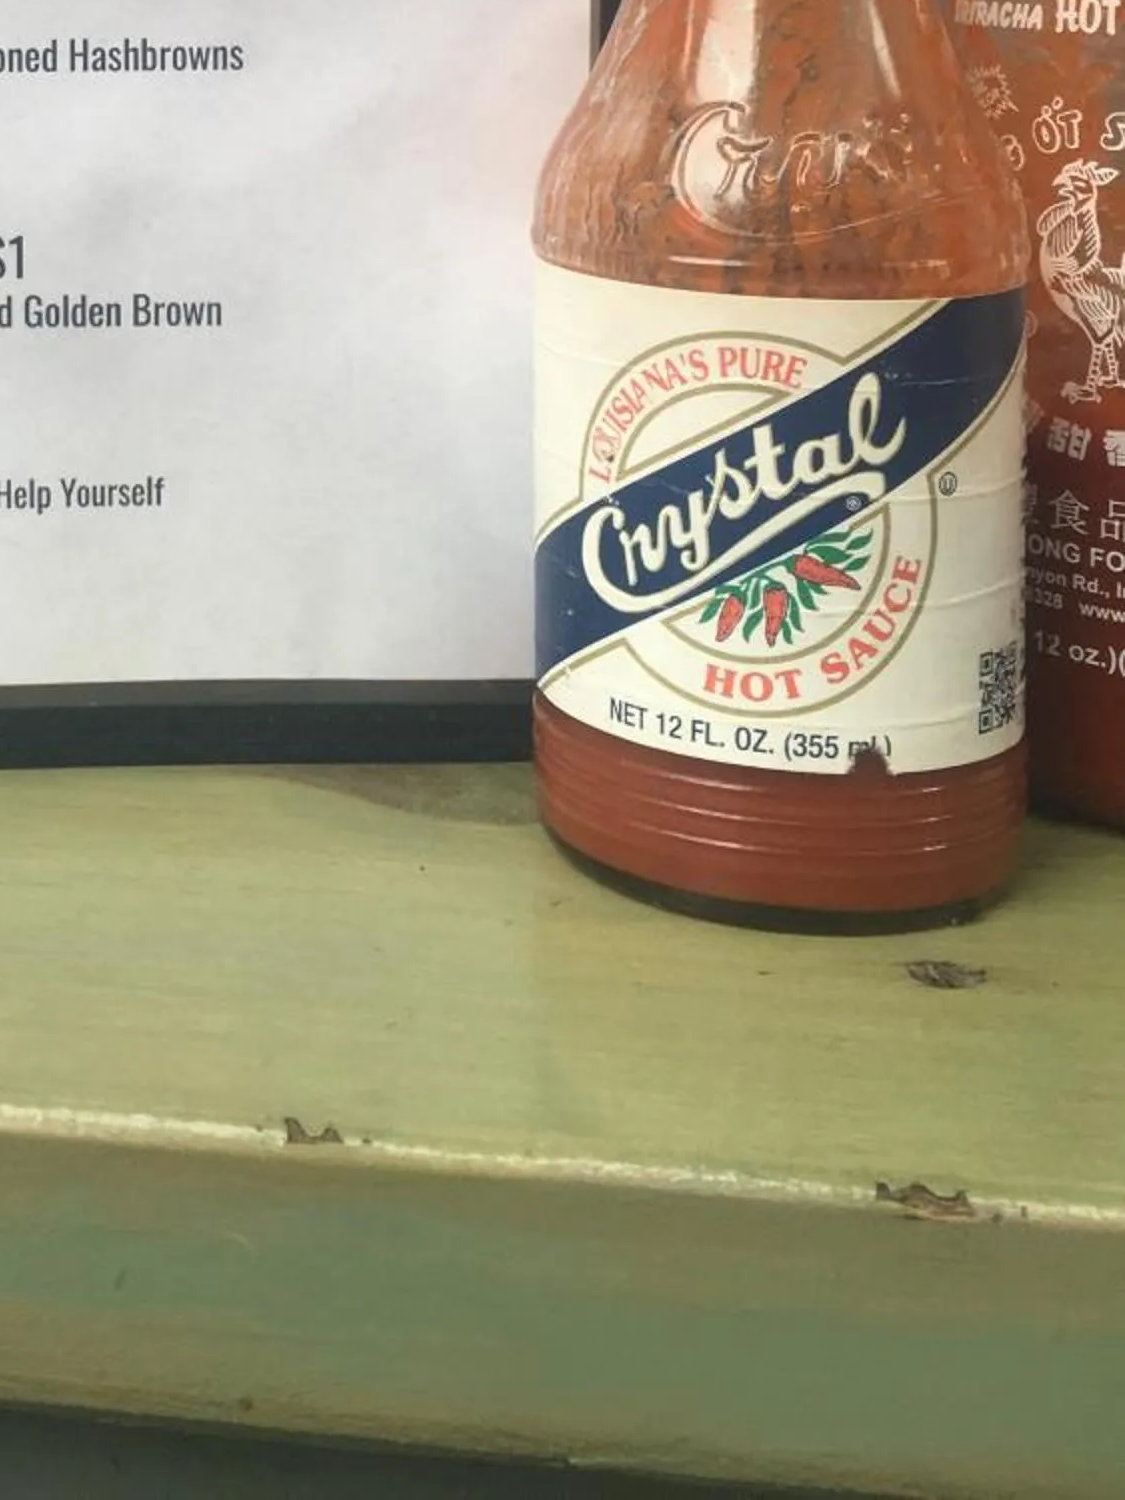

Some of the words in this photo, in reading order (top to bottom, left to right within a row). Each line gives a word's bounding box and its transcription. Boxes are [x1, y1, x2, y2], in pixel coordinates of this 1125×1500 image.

[68, 37, 245, 73] Hashbrowns
[23, 293, 122, 329] Golden
[132, 292, 223, 328] Brown
[717, 346, 808, 389] PURE
[59, 475, 166, 509] Yourself
[582, 371, 907, 614] Crystal
[702, 661, 803, 702] HOT
[819, 555, 923, 685] SAUCE
[609, 697, 648, 730] NET
[655, 711, 683, 740] 12
[690, 719, 726, 748] FL.
[734, 726, 774, 755] OZ.
[783, 732, 840, 761] (355
